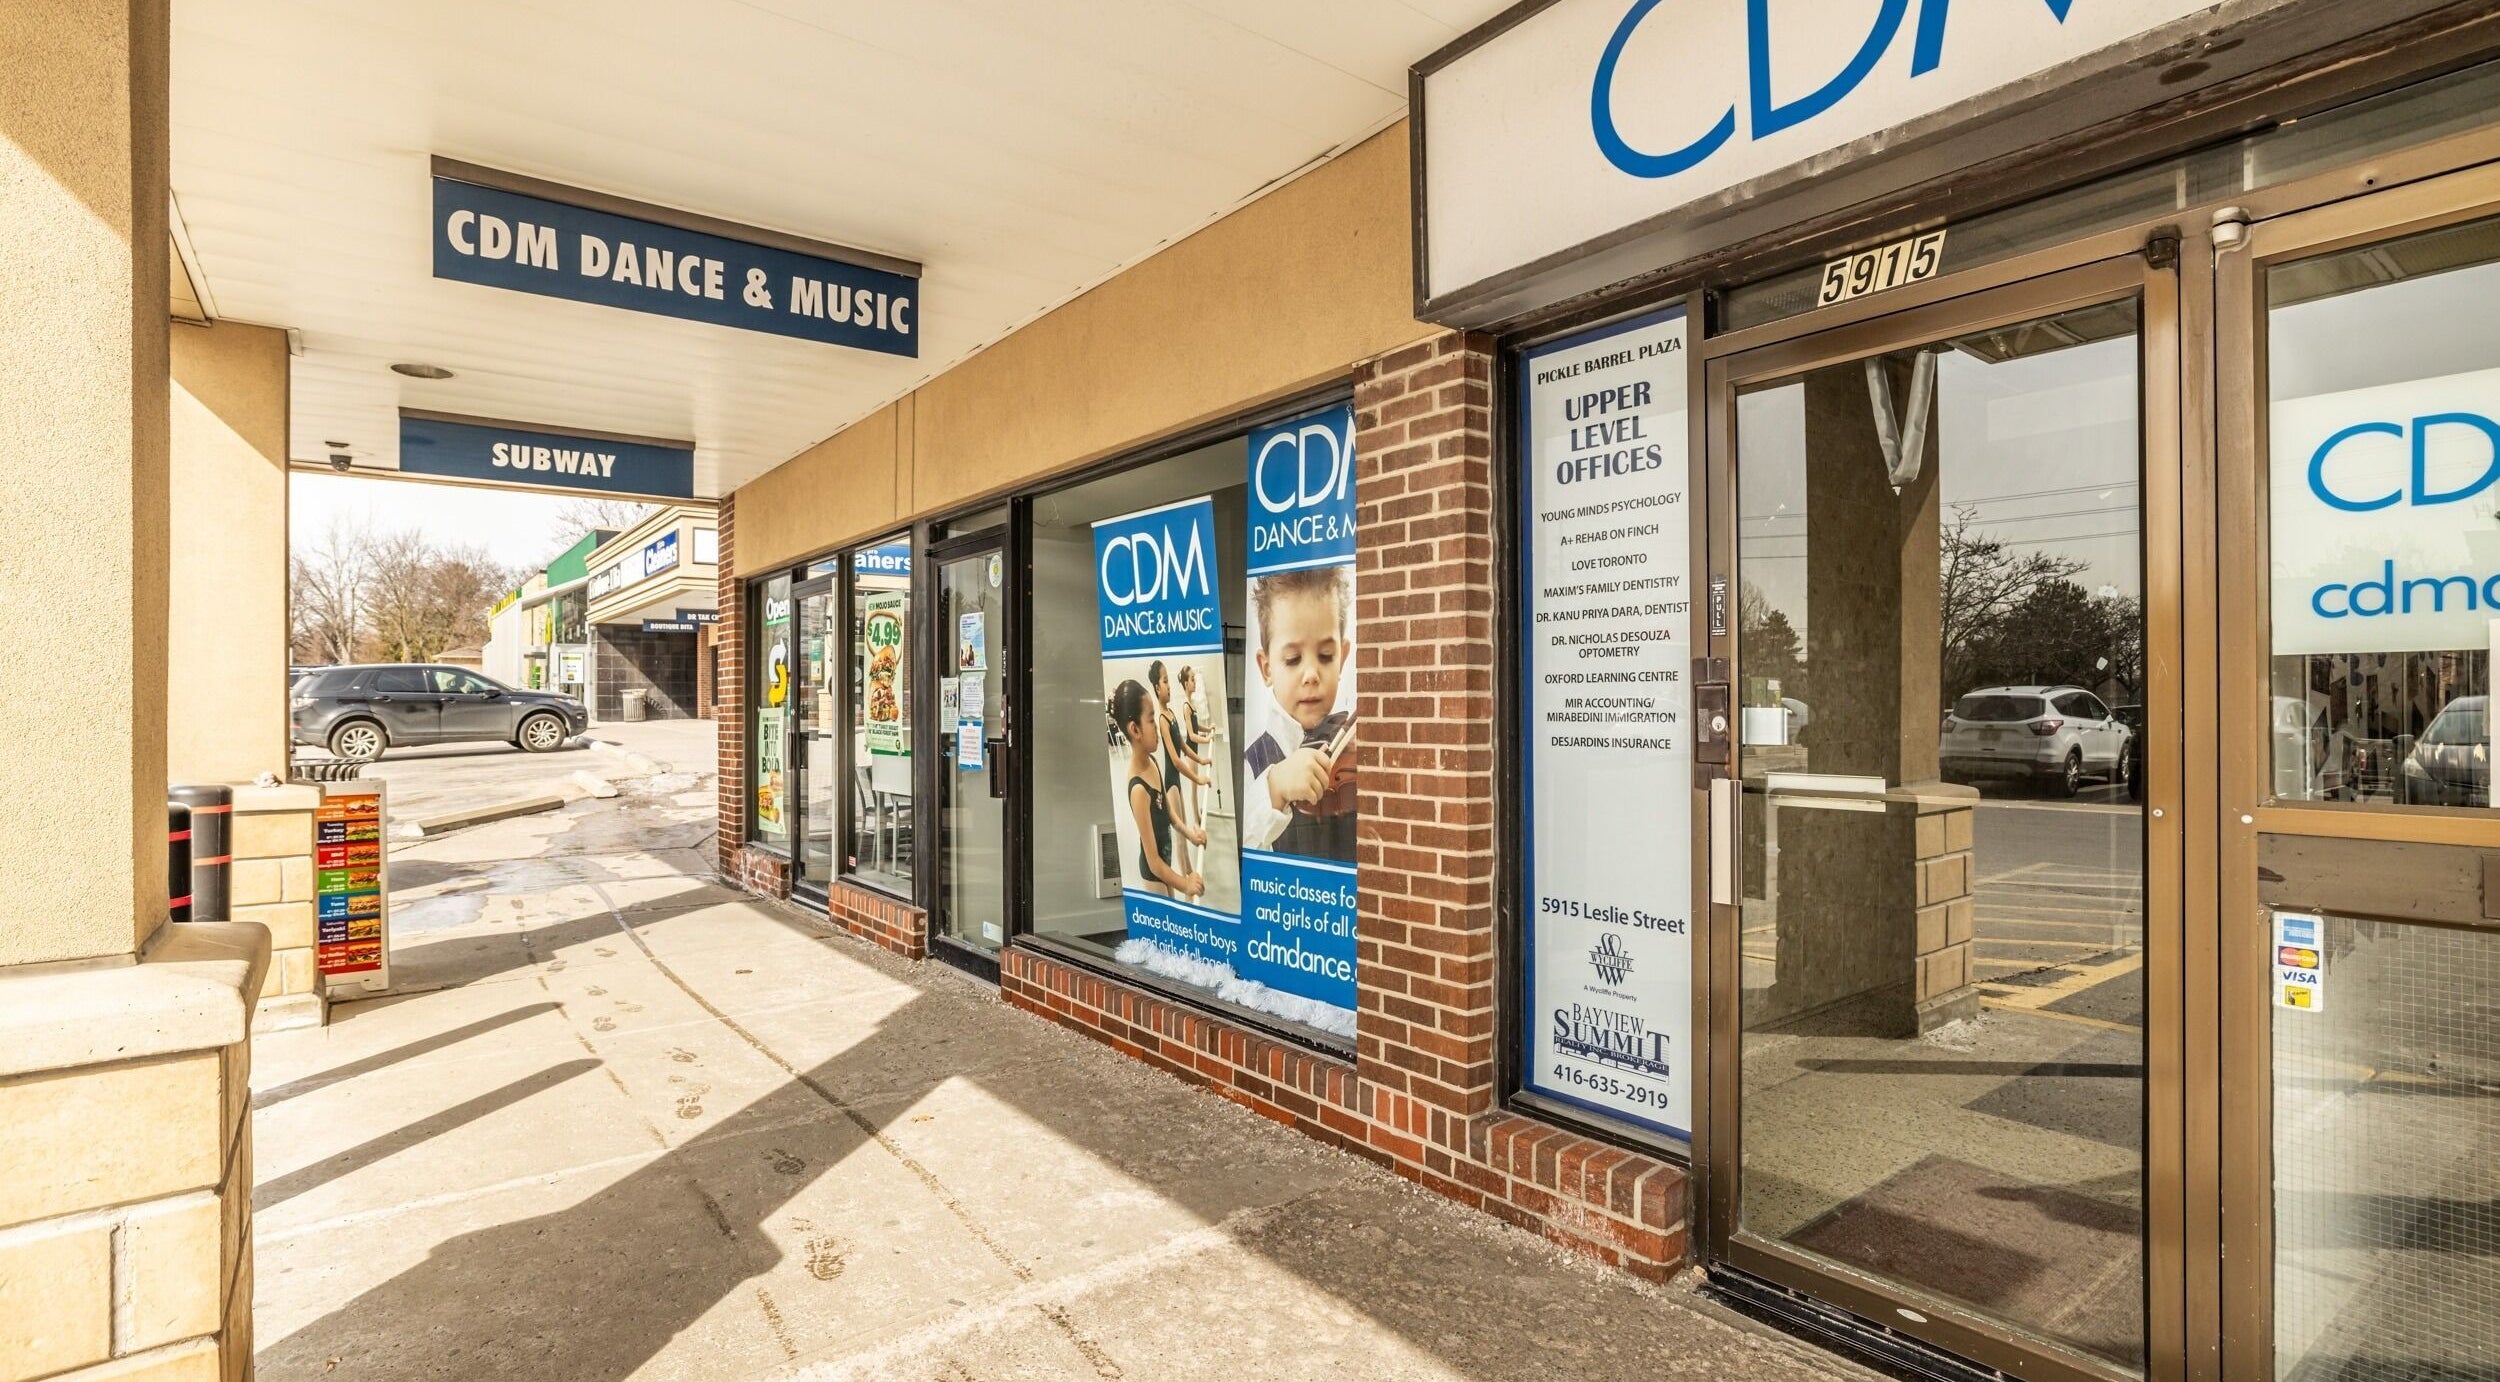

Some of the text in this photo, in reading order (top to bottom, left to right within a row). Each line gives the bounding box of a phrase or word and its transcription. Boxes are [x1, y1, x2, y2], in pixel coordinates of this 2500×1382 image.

[1591, 0, 2073, 179] CD
[447, 209, 910, 335] CDM DANCE & MUSIC
[1823, 235, 1940, 303] 5915
[1537, 337, 1682, 385] PICKLE BARREL PLAZA
[1565, 381, 1651, 421] UPPER
[1570, 415, 1647, 452] LEVEL
[491, 442, 617, 479] SUBWAY
[1556, 444, 1662, 485] OFFICES
[1541, 492, 1682, 523] YOUNG MINDS PSYCHOLOGY
[1254, 514, 1324, 553] DANCE
[1326, 515, 1339, 541] &
[1560, 523, 1660, 547] A+ REHAB ON FINCH
[1101, 517, 1210, 607] CDM
[1571, 553, 1648, 572] LOVE TORONTO
[1543, 576, 1680, 599] MAXIM'S FAMILY DENTISTRY
[766, 598, 790, 622] Open
[1104, 610, 1155, 639] DANCE
[1156, 612, 1167, 633] &
[1536, 601, 1689, 623] DR. KANU PRIYA DARA, DENTIST
[867, 621, 901, 647] $4.99
[1551, 630, 1671, 646] DR. NICHOLAS DESOUZA
[1578, 646, 1640, 659] OPTOMETRY
[1544, 671, 1679, 684] OXFORD LEARNING CENTRE
[1546, 712, 1676, 723] MIRABEDINI IMMIGRATION
[1565, 697, 1655, 709] MIR ACCOUNTING/
[1551, 736, 1671, 750] DESJARDINS INSURANCE
[1250, 877, 1286, 896] music
[1288, 877, 1337, 906] classes
[1132, 906, 1238, 956] dance classes for boys
[1256, 902, 1281, 923] and
[1282, 907, 1311, 931] girls
[1314, 911, 1329, 933] of
[1331, 914, 1349, 937] all
[1542, 897, 1685, 935] 5915 Leslie Street
[1590, 953, 1633, 970] WYCLIFFE
[2283, 971, 2318, 985] VISA
[1573, 1003, 1645, 1037] BAYVIEW
[1553, 1008, 1671, 1064] SUMMIT
[1610, 1051, 1670, 1072] BROKERAGE
[1553, 1064, 1668, 1110] 416-635-2919
